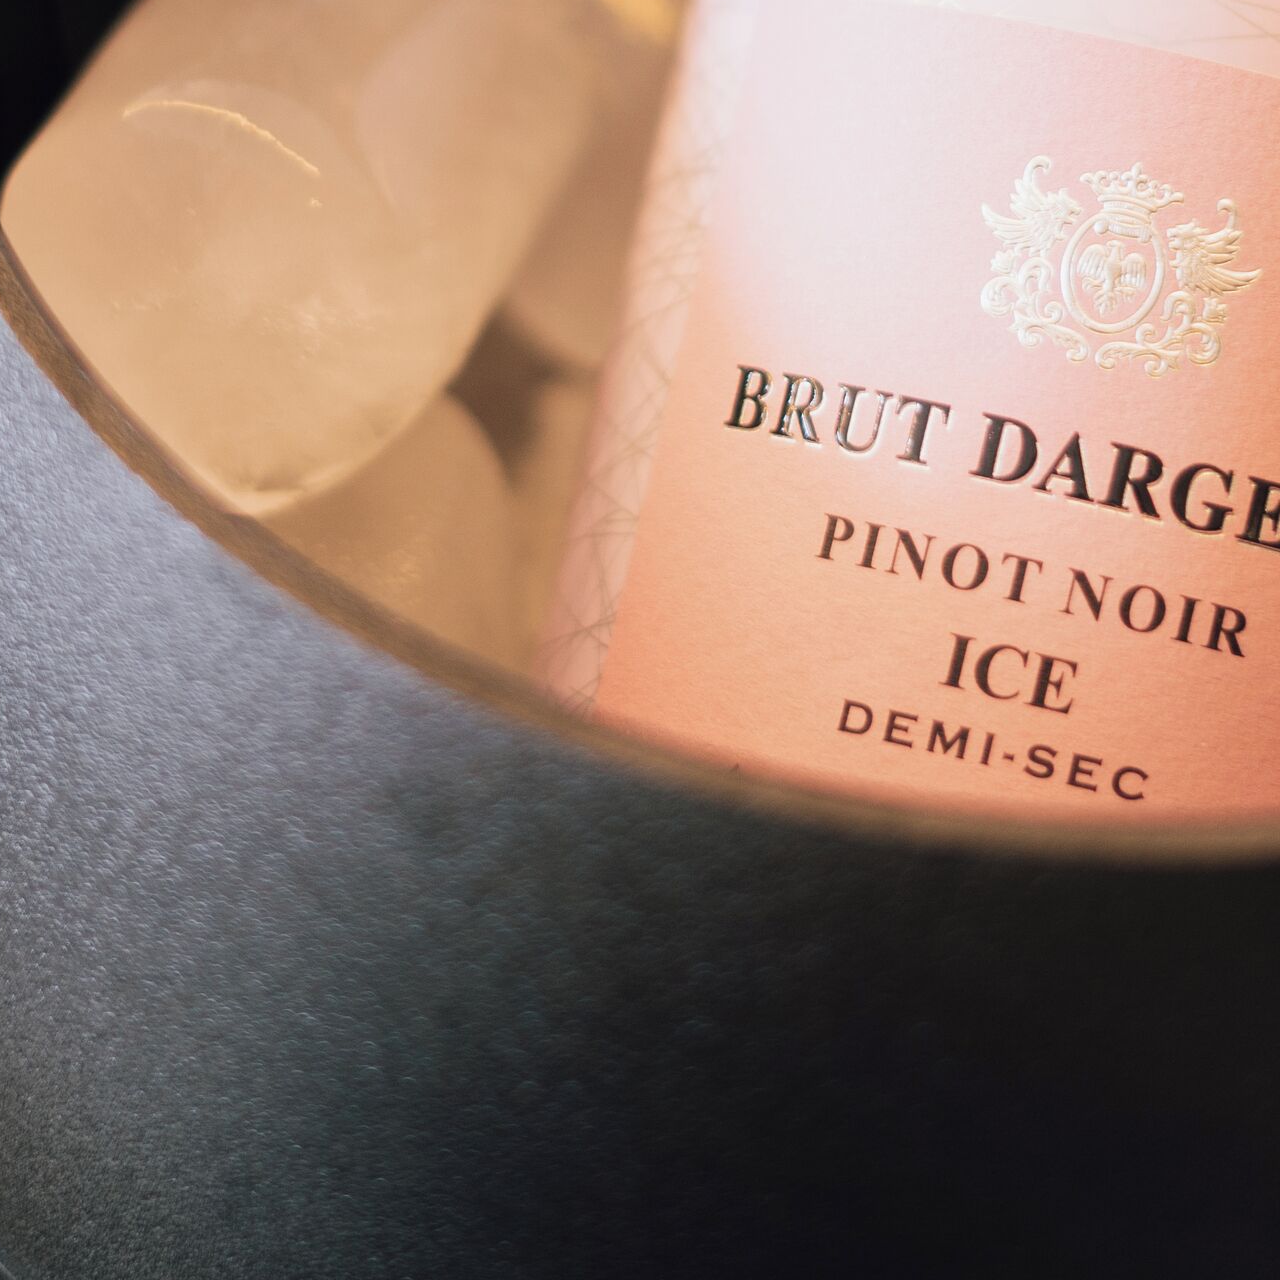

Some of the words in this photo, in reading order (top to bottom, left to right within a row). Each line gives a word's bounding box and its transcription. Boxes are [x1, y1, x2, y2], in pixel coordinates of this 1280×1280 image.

[723, 364, 950, 465] BRUT
[816, 513, 1043, 604] PINOT
[1063, 568, 1248, 658] NOIR
[940, 632, 1078, 715] ICE
[837, 699, 1149, 801] DEMI-SEC
